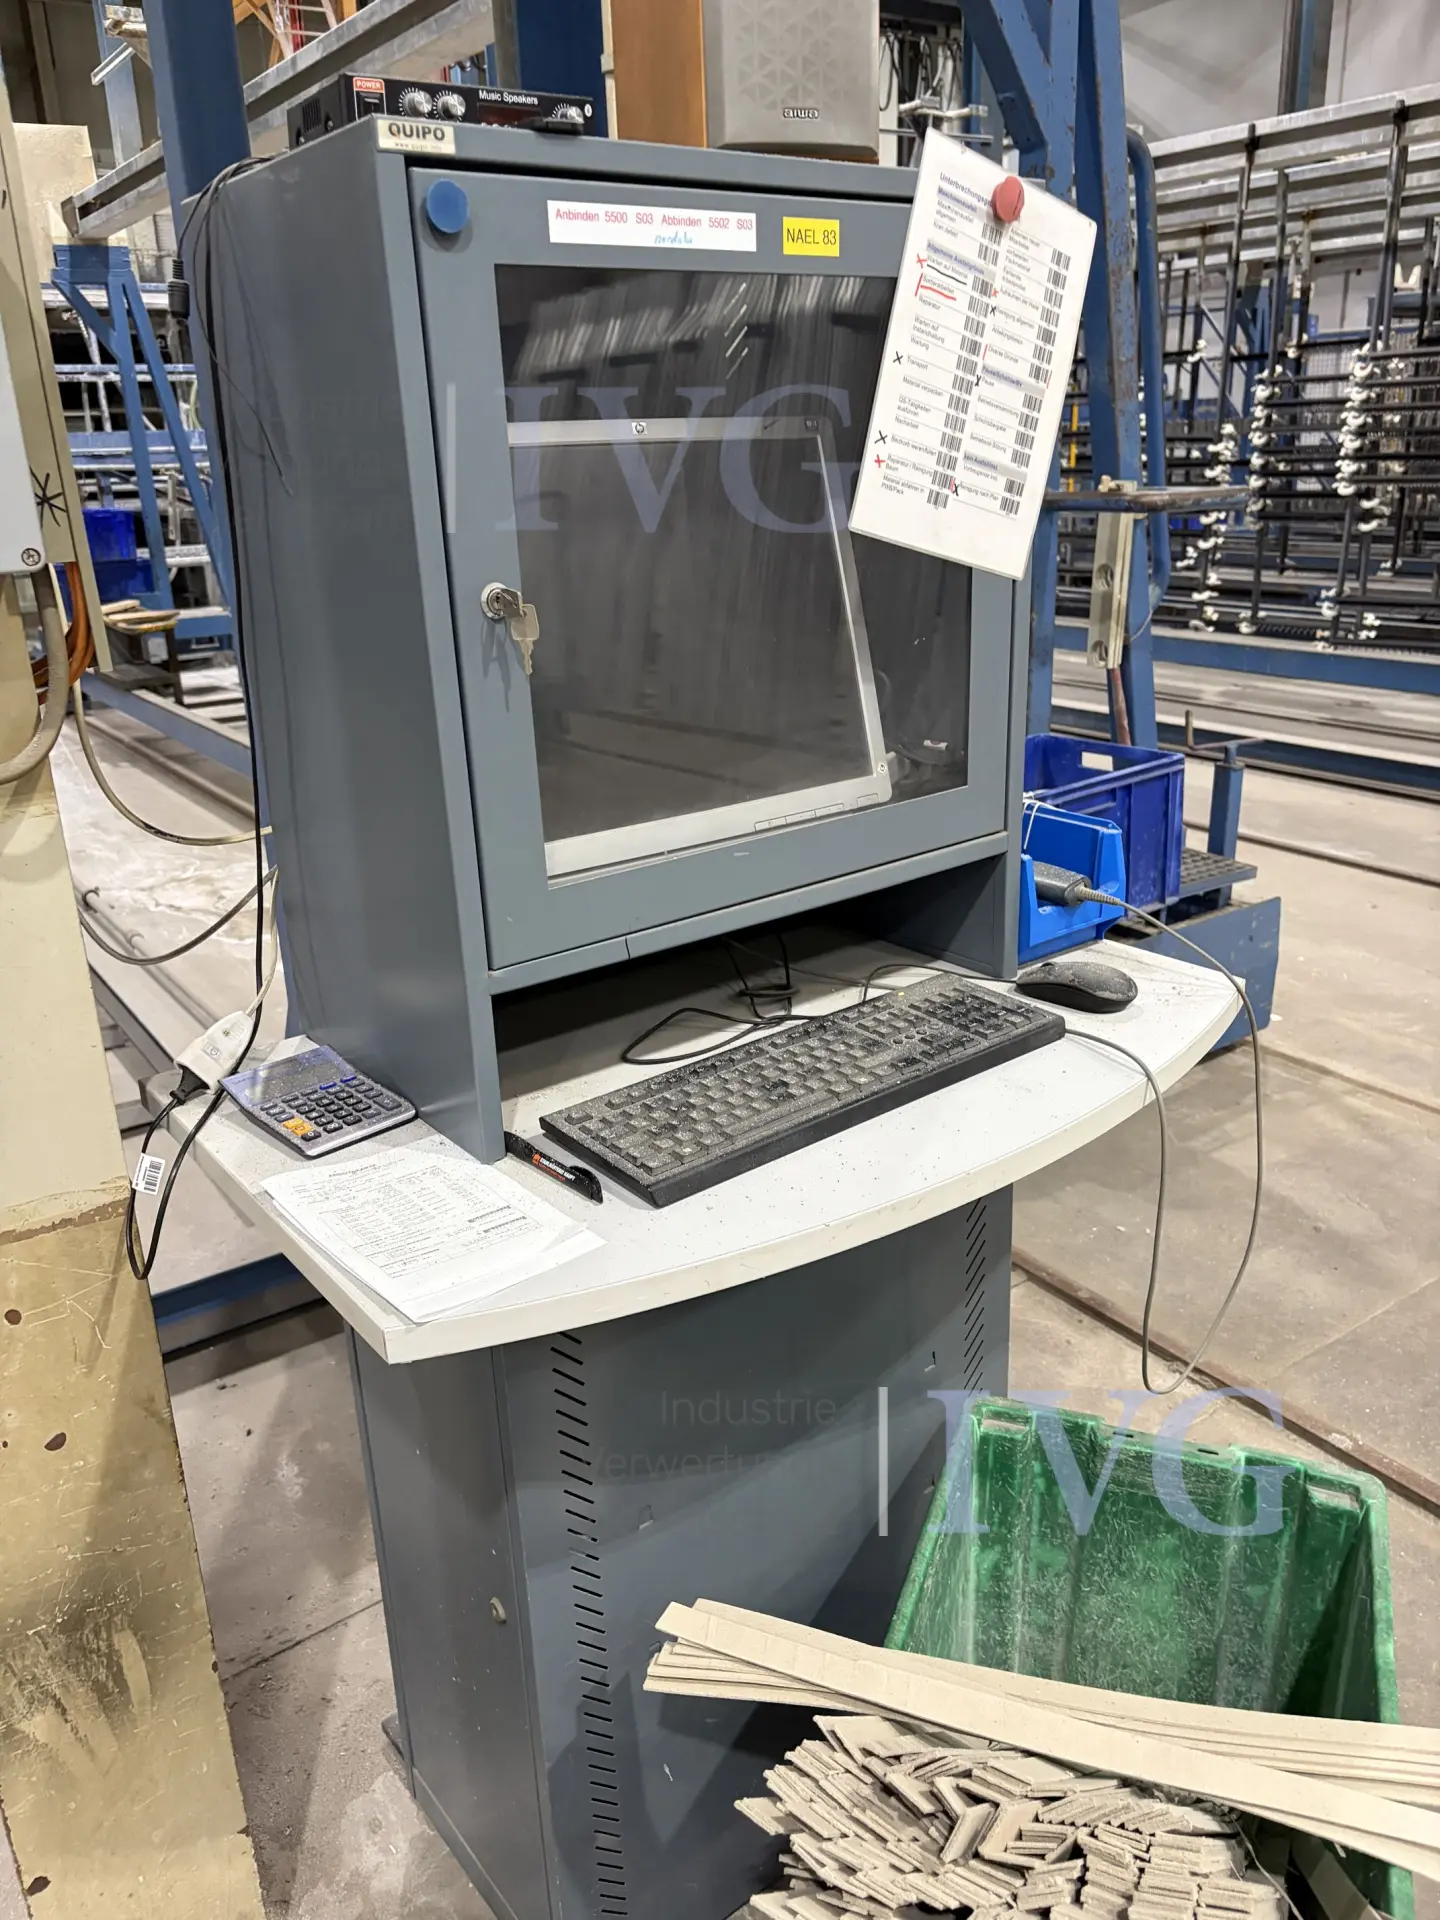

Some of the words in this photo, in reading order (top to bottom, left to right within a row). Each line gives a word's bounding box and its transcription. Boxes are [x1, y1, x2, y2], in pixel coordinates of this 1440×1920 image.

[357, 81, 381, 89] POWER
[479, 89, 502, 101] Music
[503, 91, 539, 106] Speakers
[388, 122, 446, 141] QUIPO
[555, 208, 600, 221] Anbinden
[604, 210, 628, 224] 5500
[635, 212, 654, 225] S03
[661, 214, 702, 228] Abbinden
[736, 218, 753, 231] S03
[786, 227, 820, 245] NAEL
[822, 229, 837, 246] 83
[911, 337, 929, 350] Wartung
[907, 357, 928, 371] Transport
